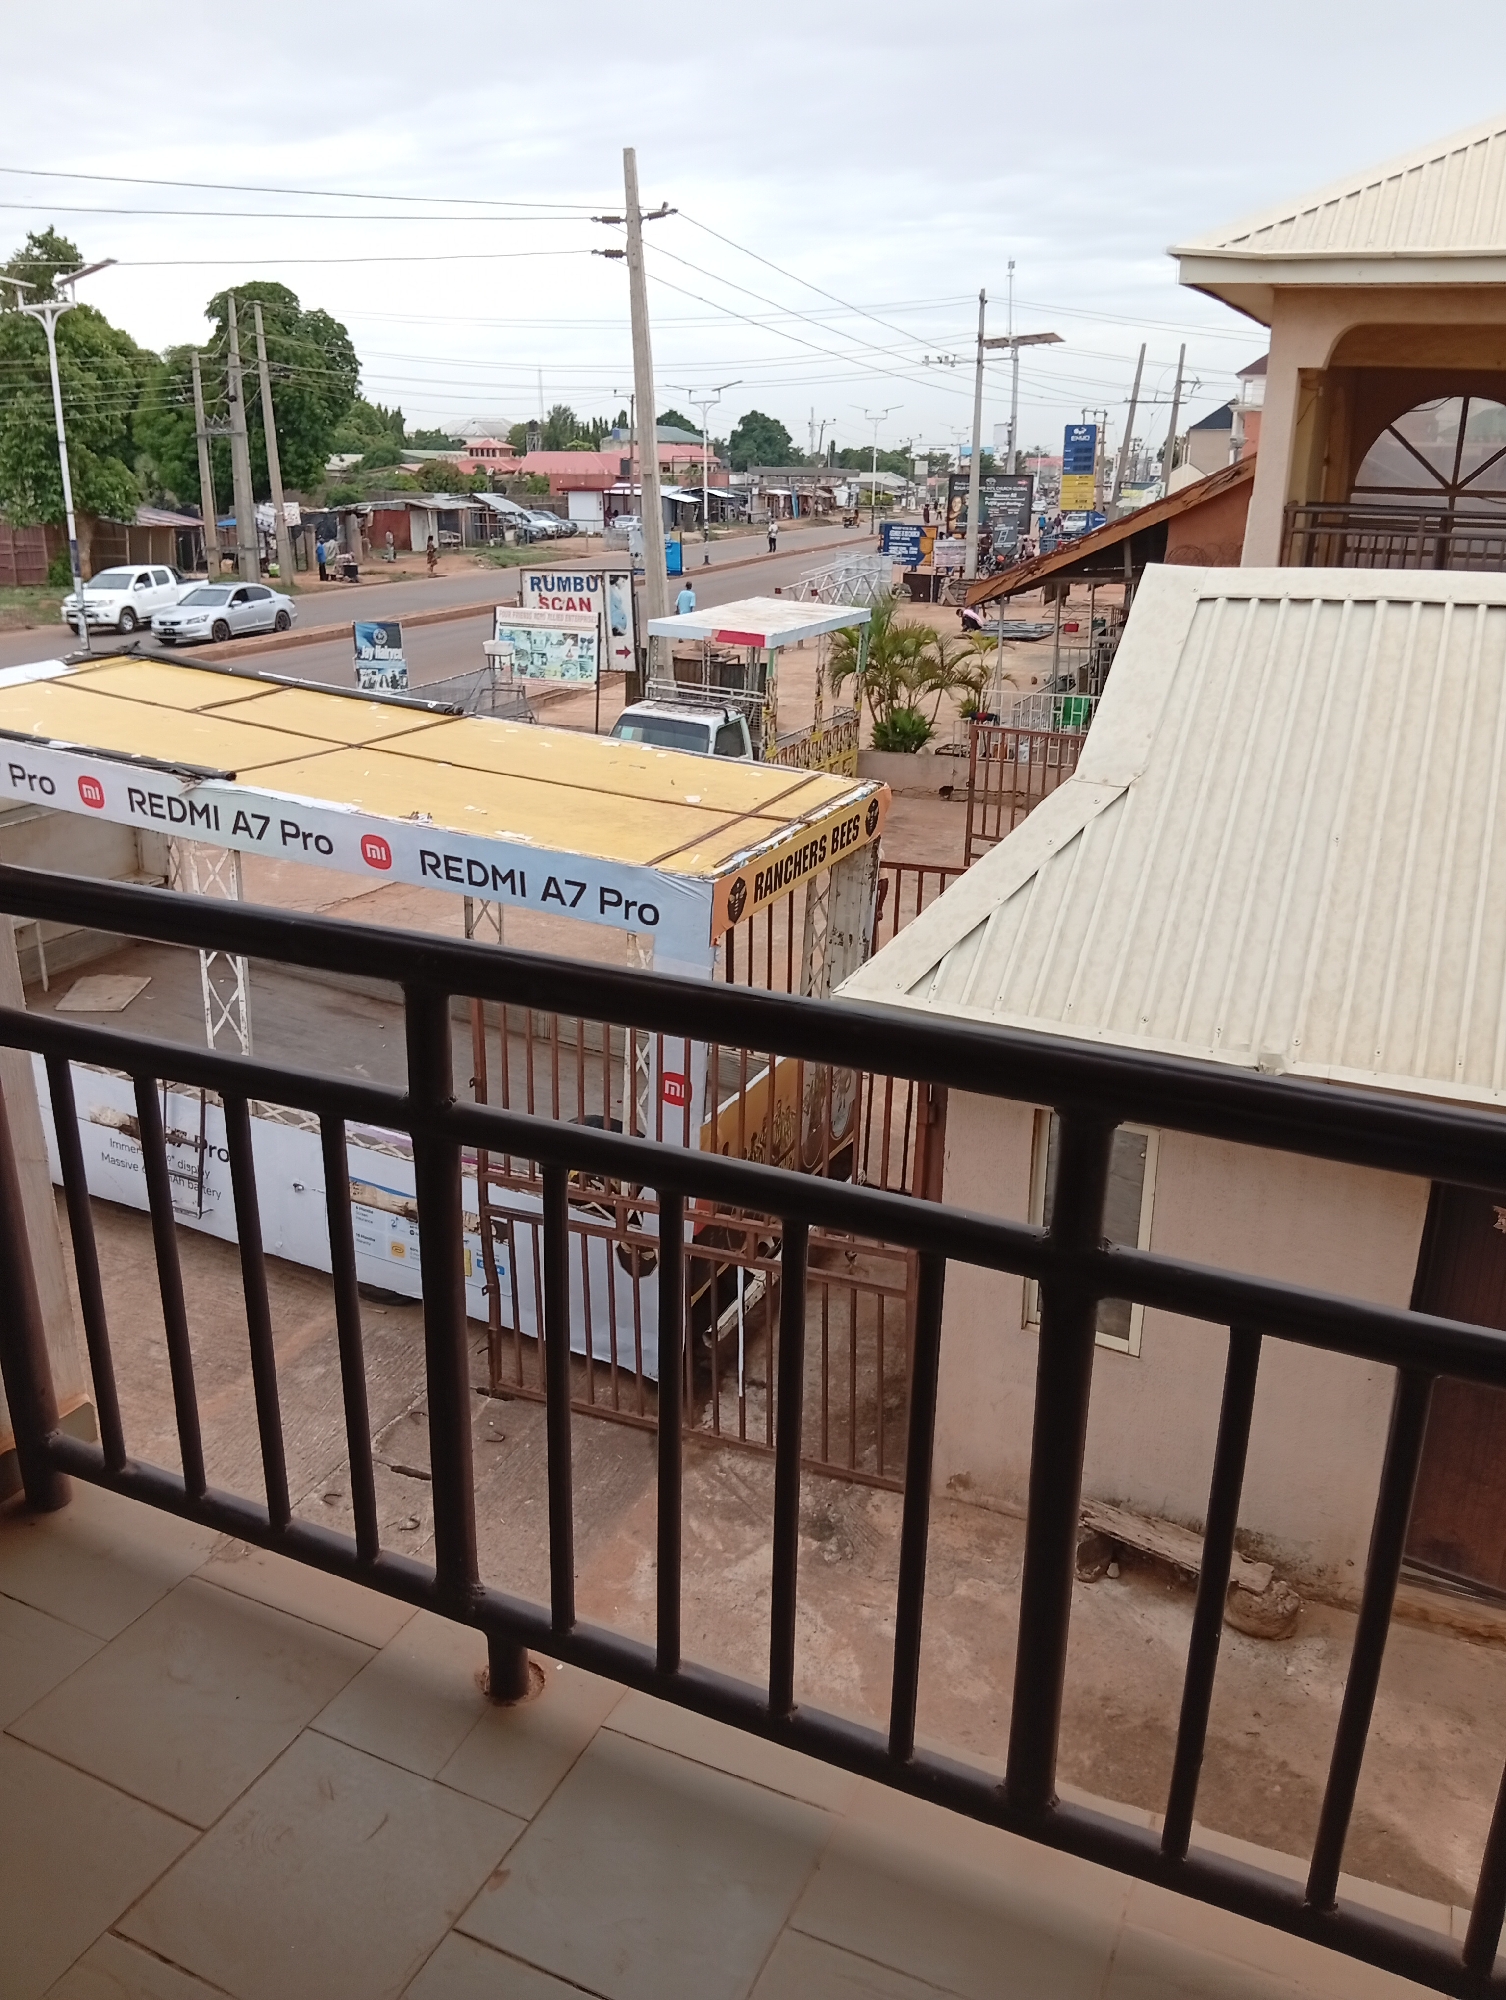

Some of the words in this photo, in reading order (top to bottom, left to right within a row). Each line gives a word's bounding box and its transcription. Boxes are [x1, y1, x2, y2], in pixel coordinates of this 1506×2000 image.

[539, 596, 592, 612] SCAN
[8, 763, 56, 796] Pro
[127, 787, 221, 832] REDMI
[231, 810, 271, 841] A7
[280, 819, 334, 856] Pro
[419, 849, 527, 898] REDMI
[540, 875, 587, 908] A7
[599, 886, 660, 926] Pro
[754, 834, 827, 904] RANCHERS
[831, 814, 861, 856] BEES
[101, 1151, 139, 1172] Massive
[187, 1179, 222, 1200] batery
[177, 1159, 211, 1179] disply
